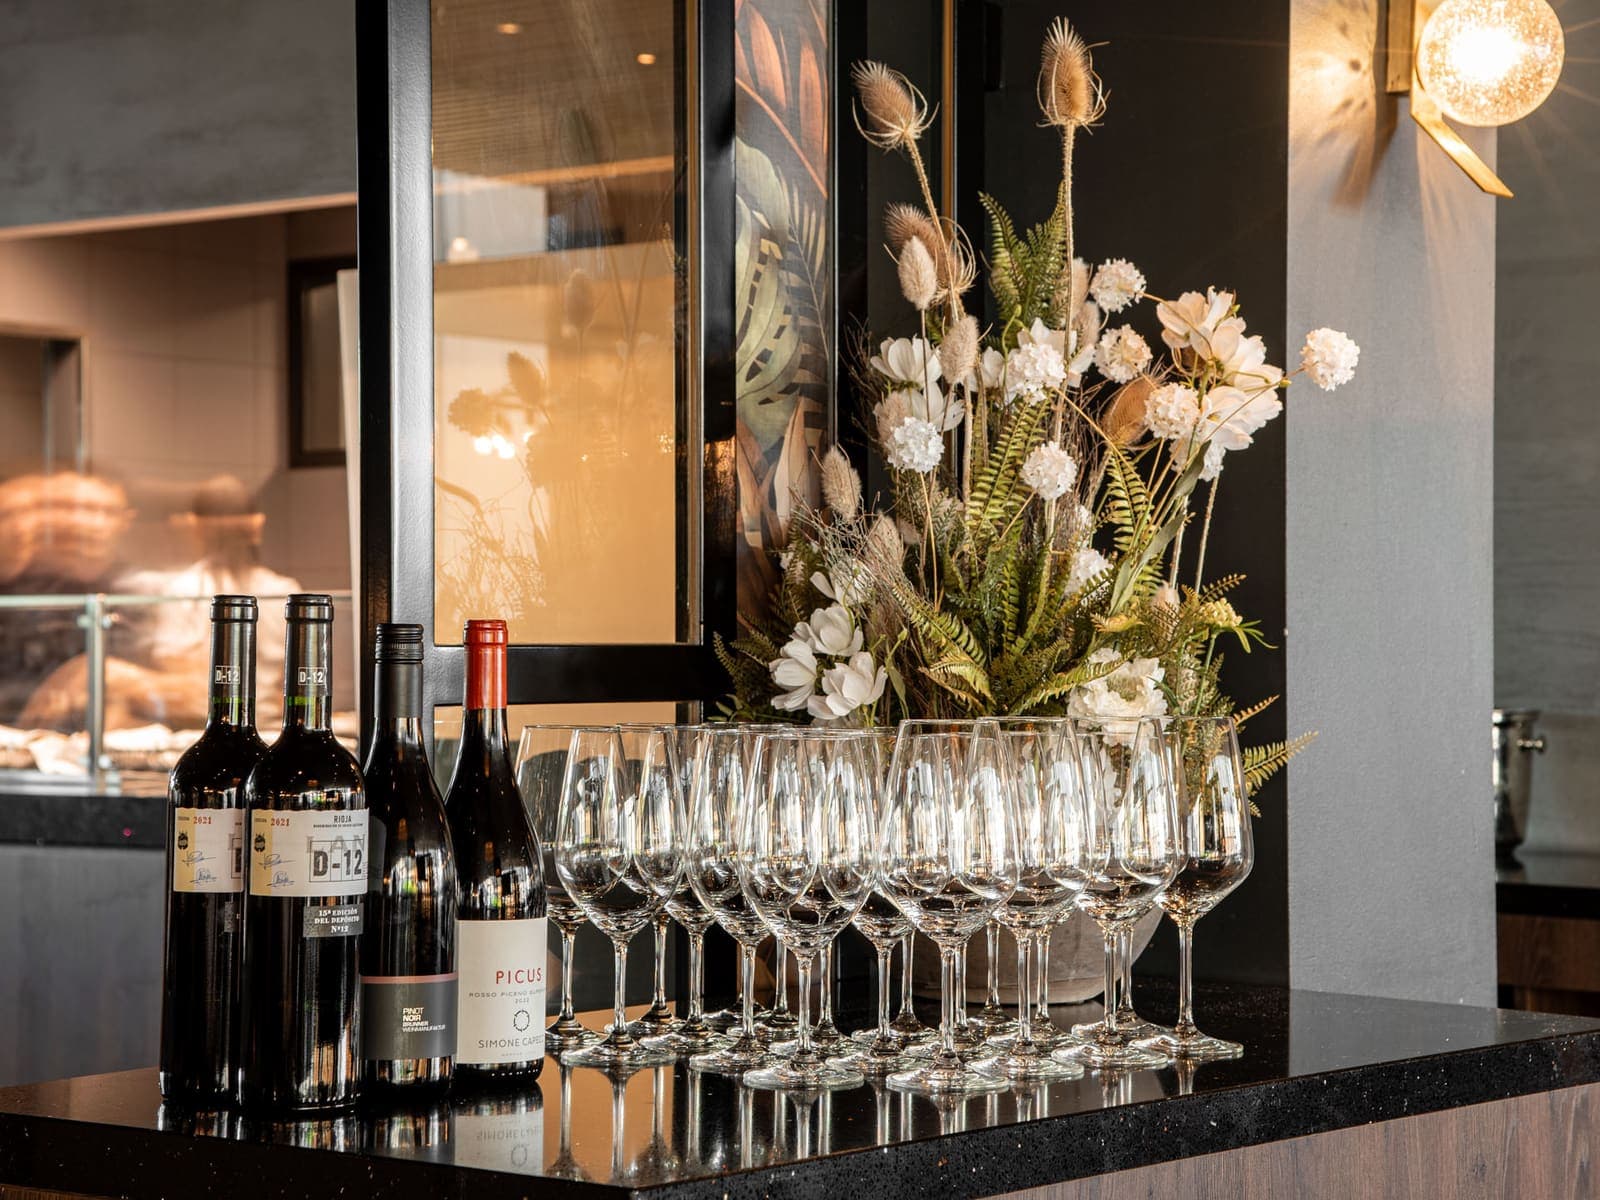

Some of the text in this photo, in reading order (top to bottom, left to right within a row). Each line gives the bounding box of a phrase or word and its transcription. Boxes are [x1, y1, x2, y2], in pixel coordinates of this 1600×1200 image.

[215, 669, 240, 682] D-12
[299, 671, 324, 683] D-12
[193, 816, 212, 824] 2021
[270, 818, 290, 826] 2021
[333, 815, 352, 823] RIOJA
[313, 849, 362, 876] D-12
[495, 967, 542, 984] PICUS
[478, 1039, 520, 1048] SIMONE
